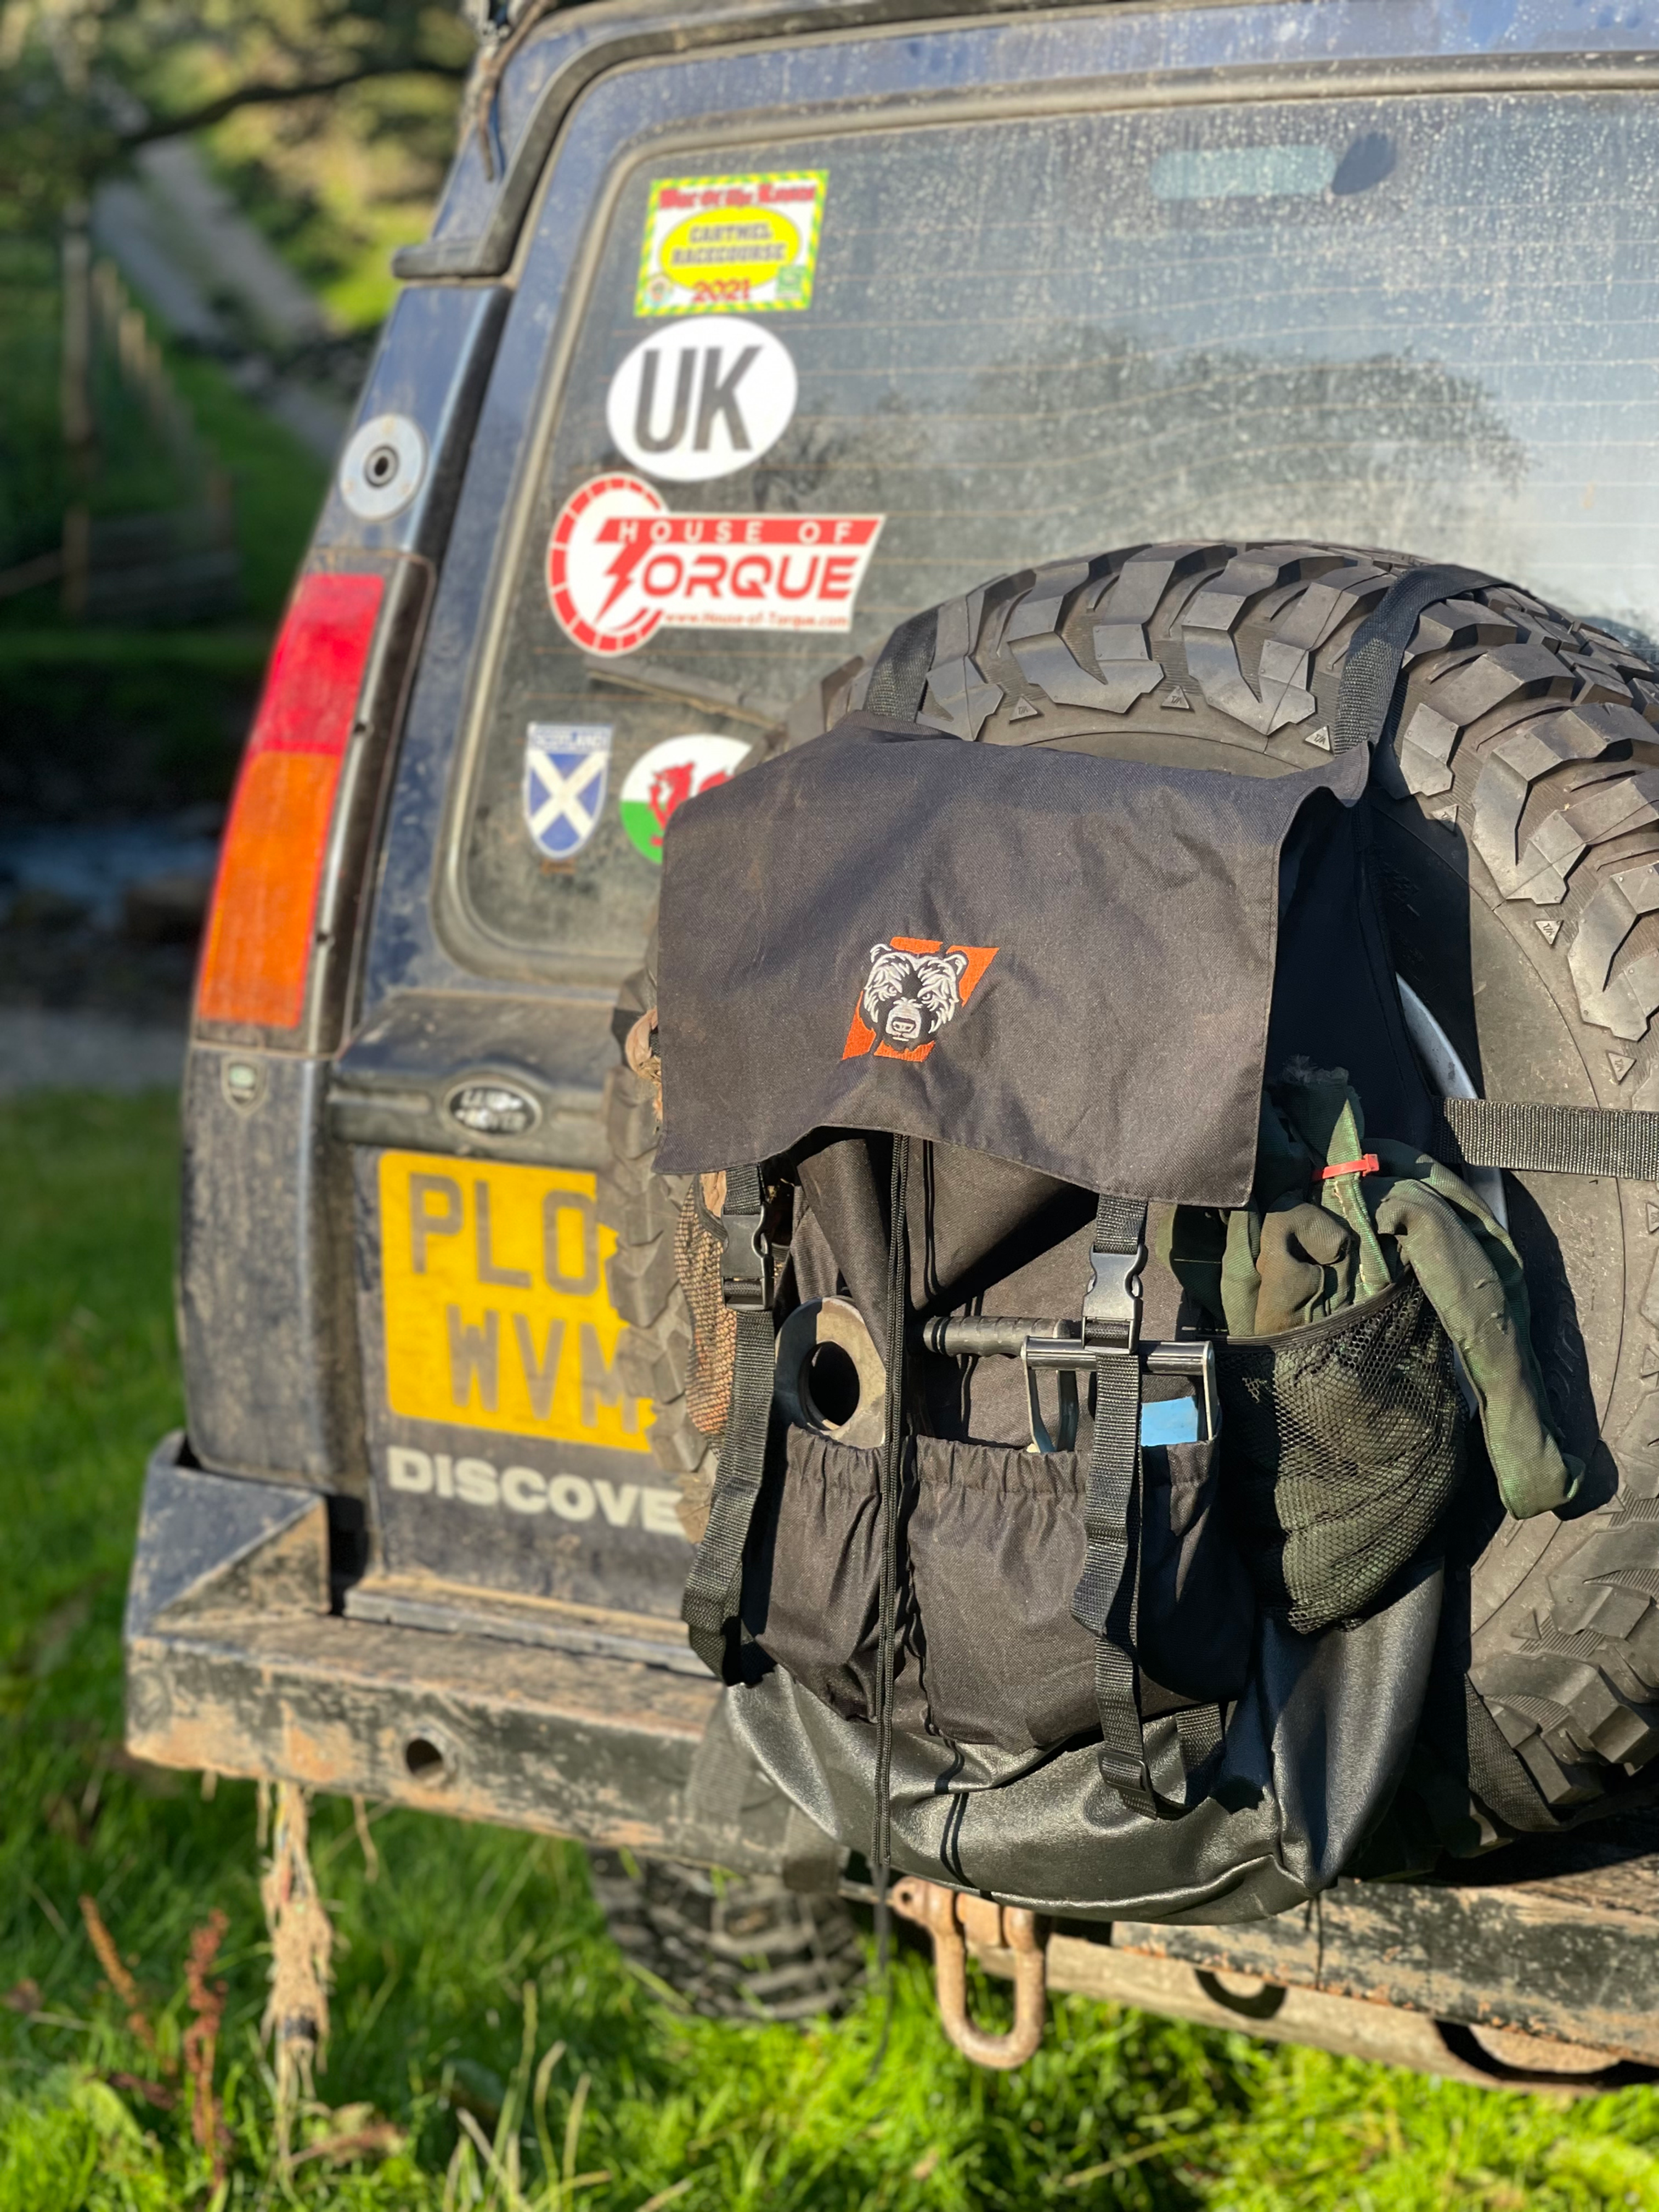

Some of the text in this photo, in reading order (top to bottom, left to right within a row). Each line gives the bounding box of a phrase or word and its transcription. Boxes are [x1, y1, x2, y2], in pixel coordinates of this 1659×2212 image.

[692, 278, 751, 303] 2021
[634, 346, 763, 454] UK
[618, 520, 852, 544] HOUSE OF
